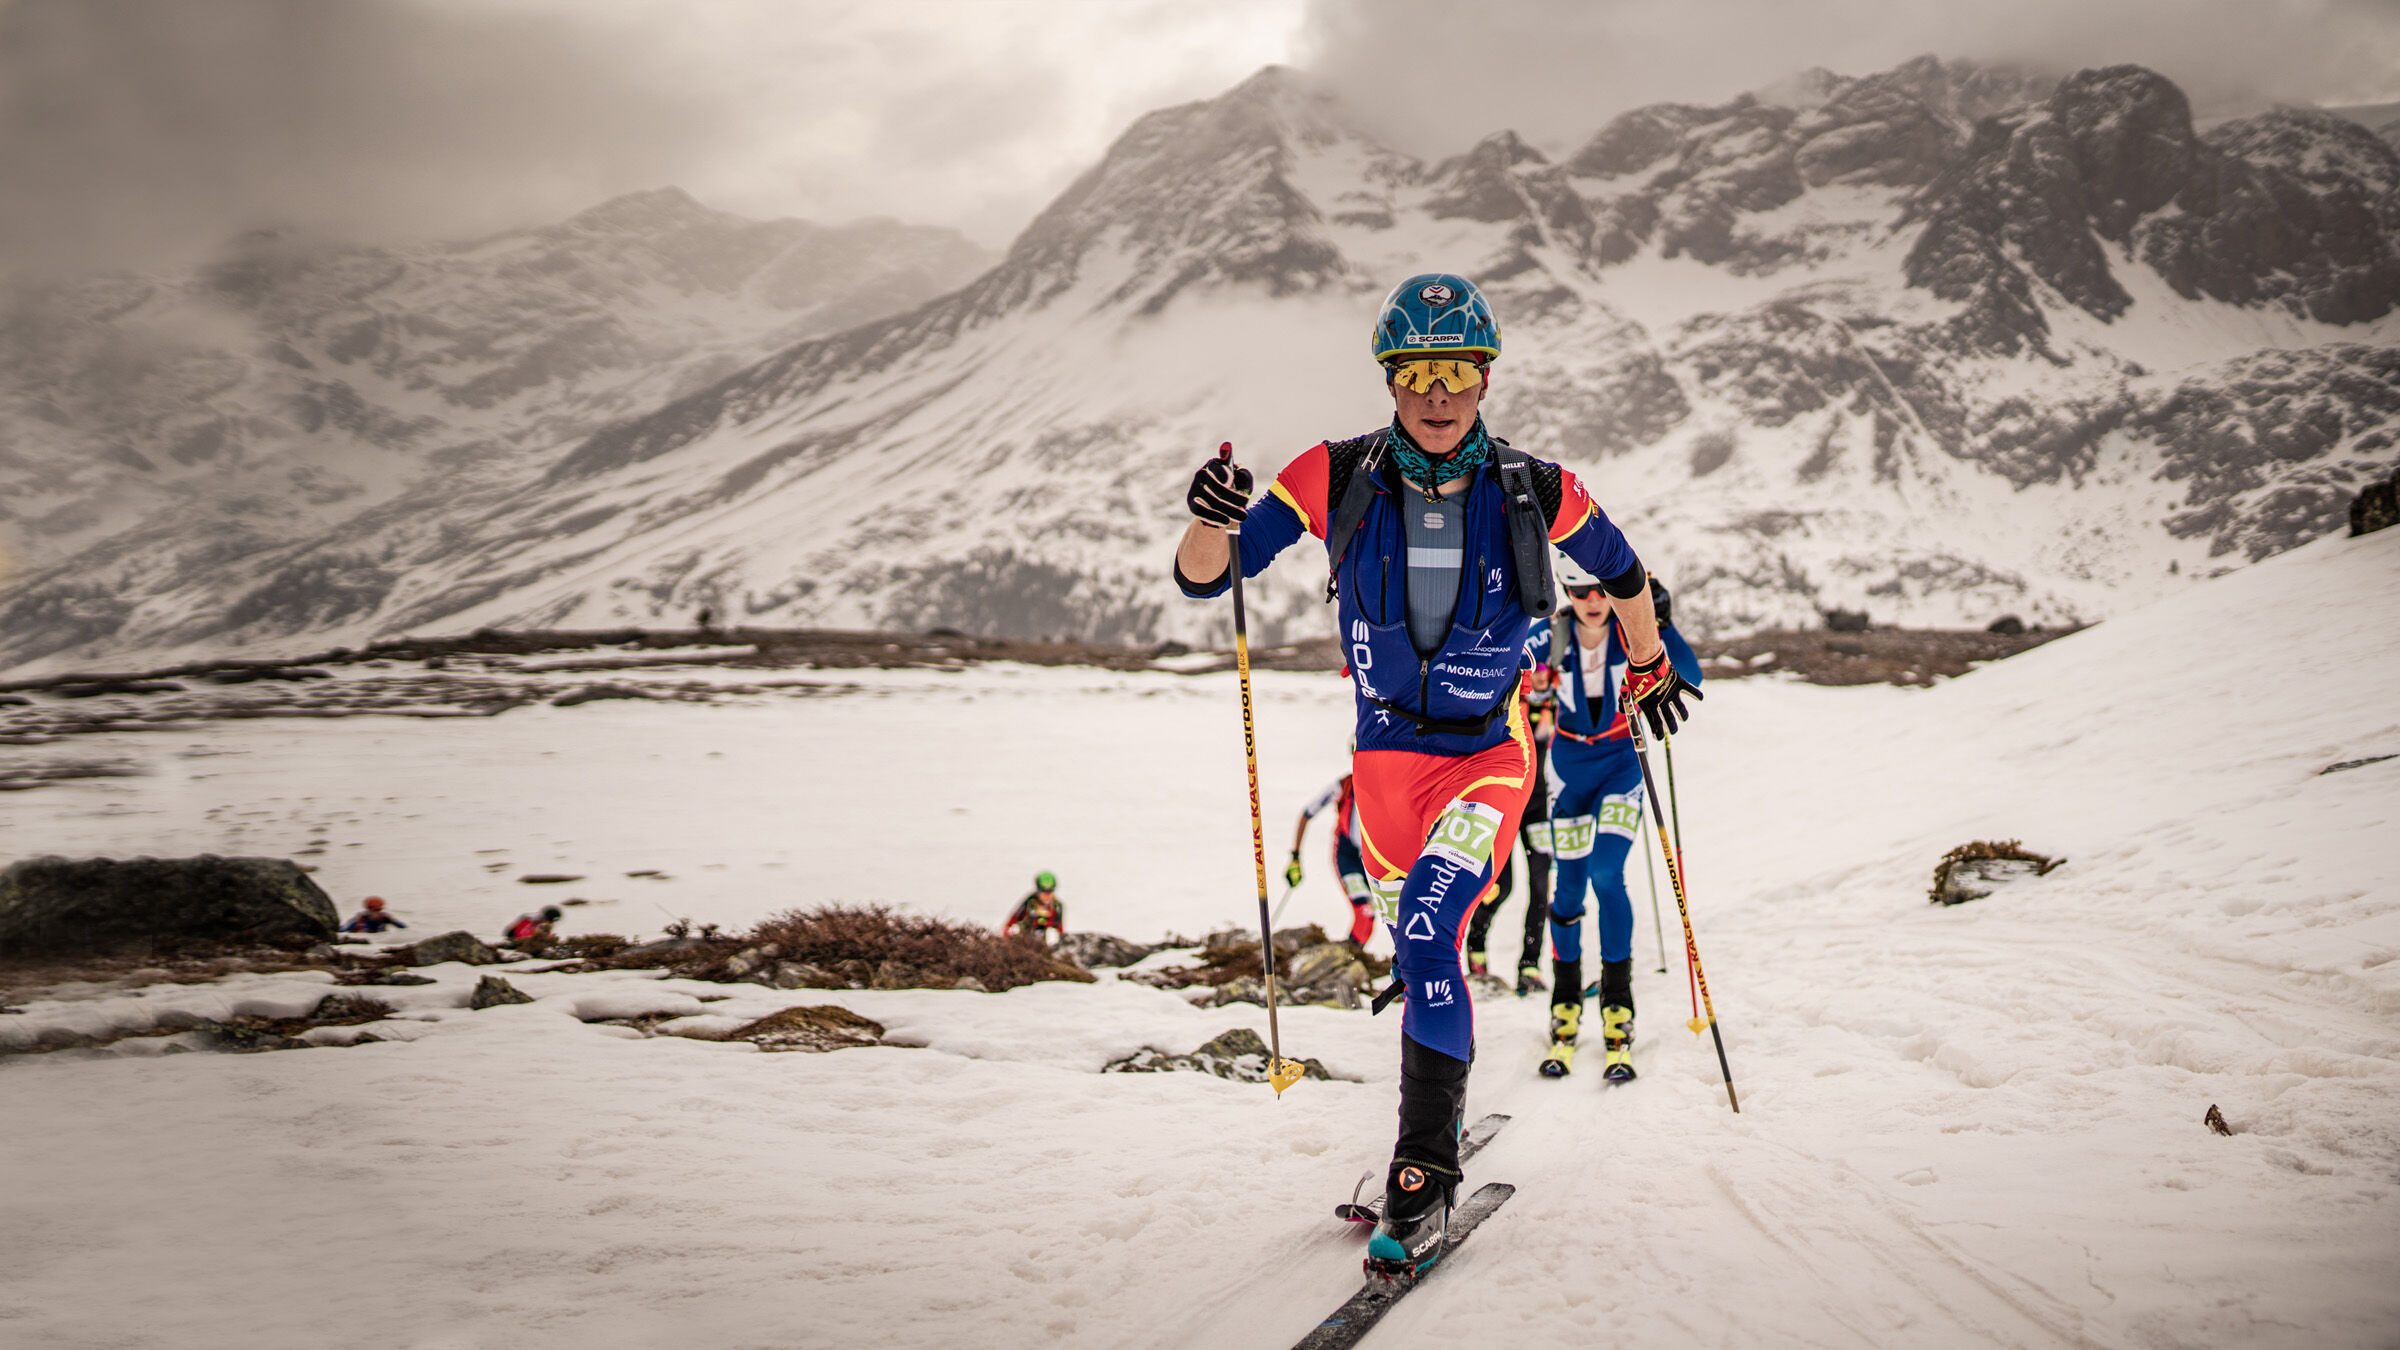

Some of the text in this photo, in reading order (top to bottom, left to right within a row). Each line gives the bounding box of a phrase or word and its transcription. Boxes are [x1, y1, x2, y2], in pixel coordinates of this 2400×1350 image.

[1418, 335, 1460, 343] SCARPA
[1501, 461, 1526, 470] MILLET
[1446, 664, 1508, 679] MORABANC
[1440, 682, 1495, 700] Viladomat
[1240, 679, 1254, 757] carbon
[1601, 805, 1637, 828] 214
[1556, 826, 1590, 849] 214
[1412, 1230, 1442, 1257] SCARPA
